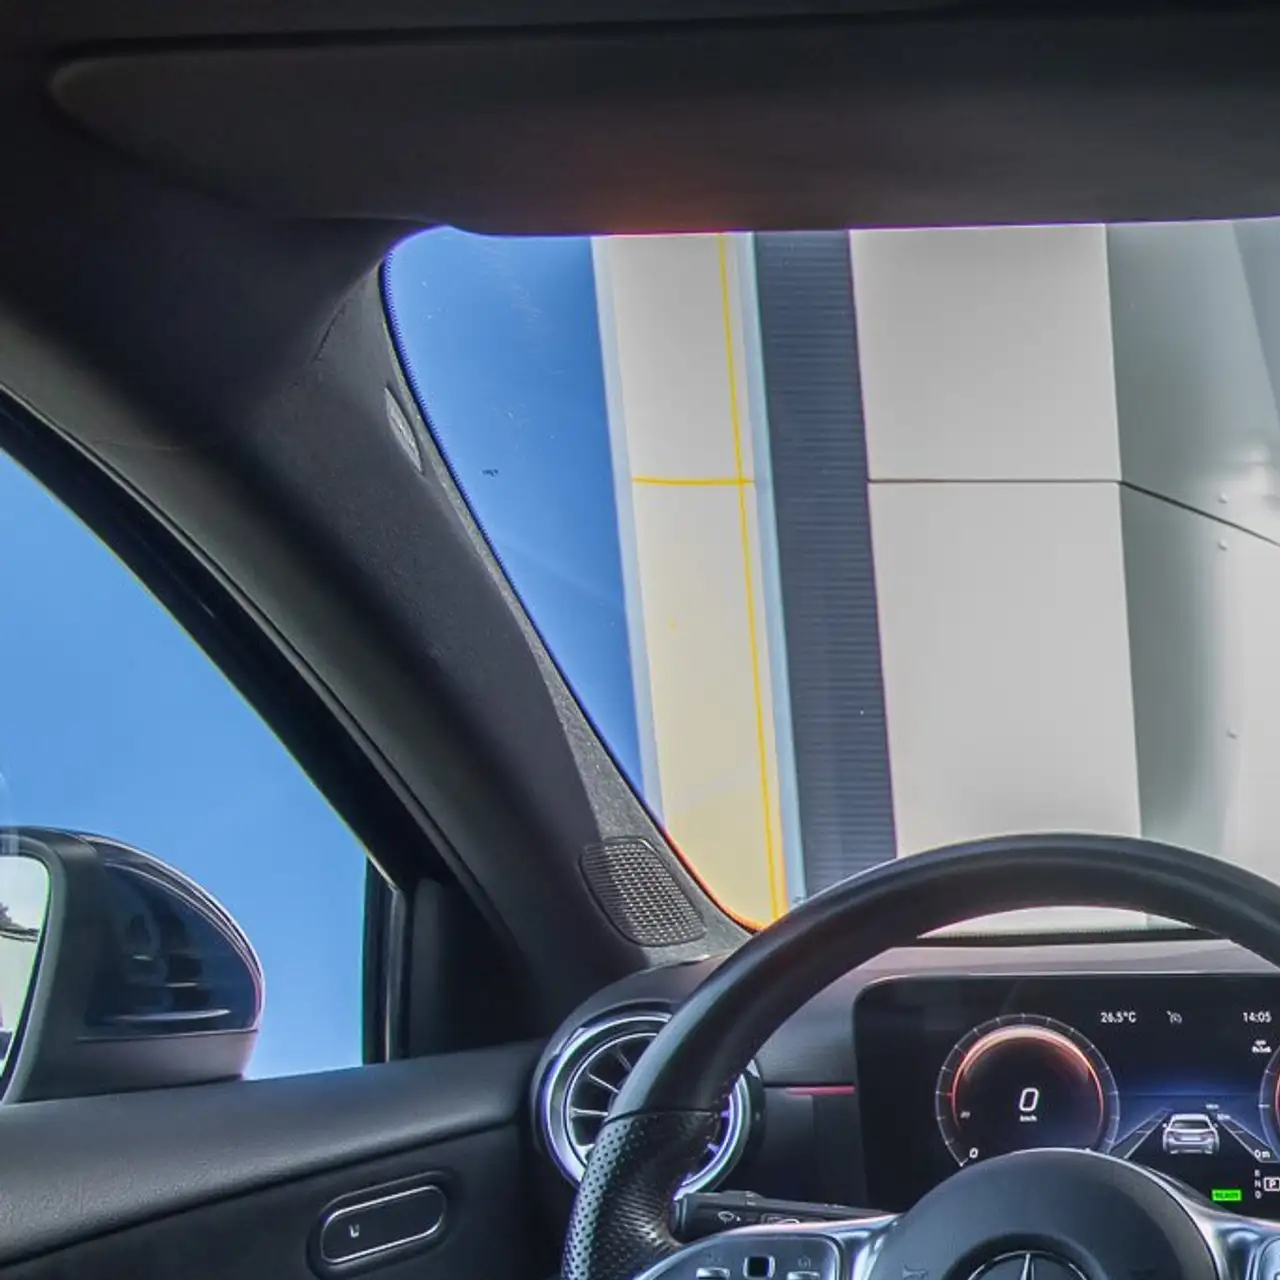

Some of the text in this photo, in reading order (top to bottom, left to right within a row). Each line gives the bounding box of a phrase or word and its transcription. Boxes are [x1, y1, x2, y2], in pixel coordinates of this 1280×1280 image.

[1100, 1011, 1137, 1023] 26.5°C
[1243, 1011, 1272, 1023] 14:05
[1019, 1087, 1039, 1112] 0
[969, 1147, 979, 1158] 0
